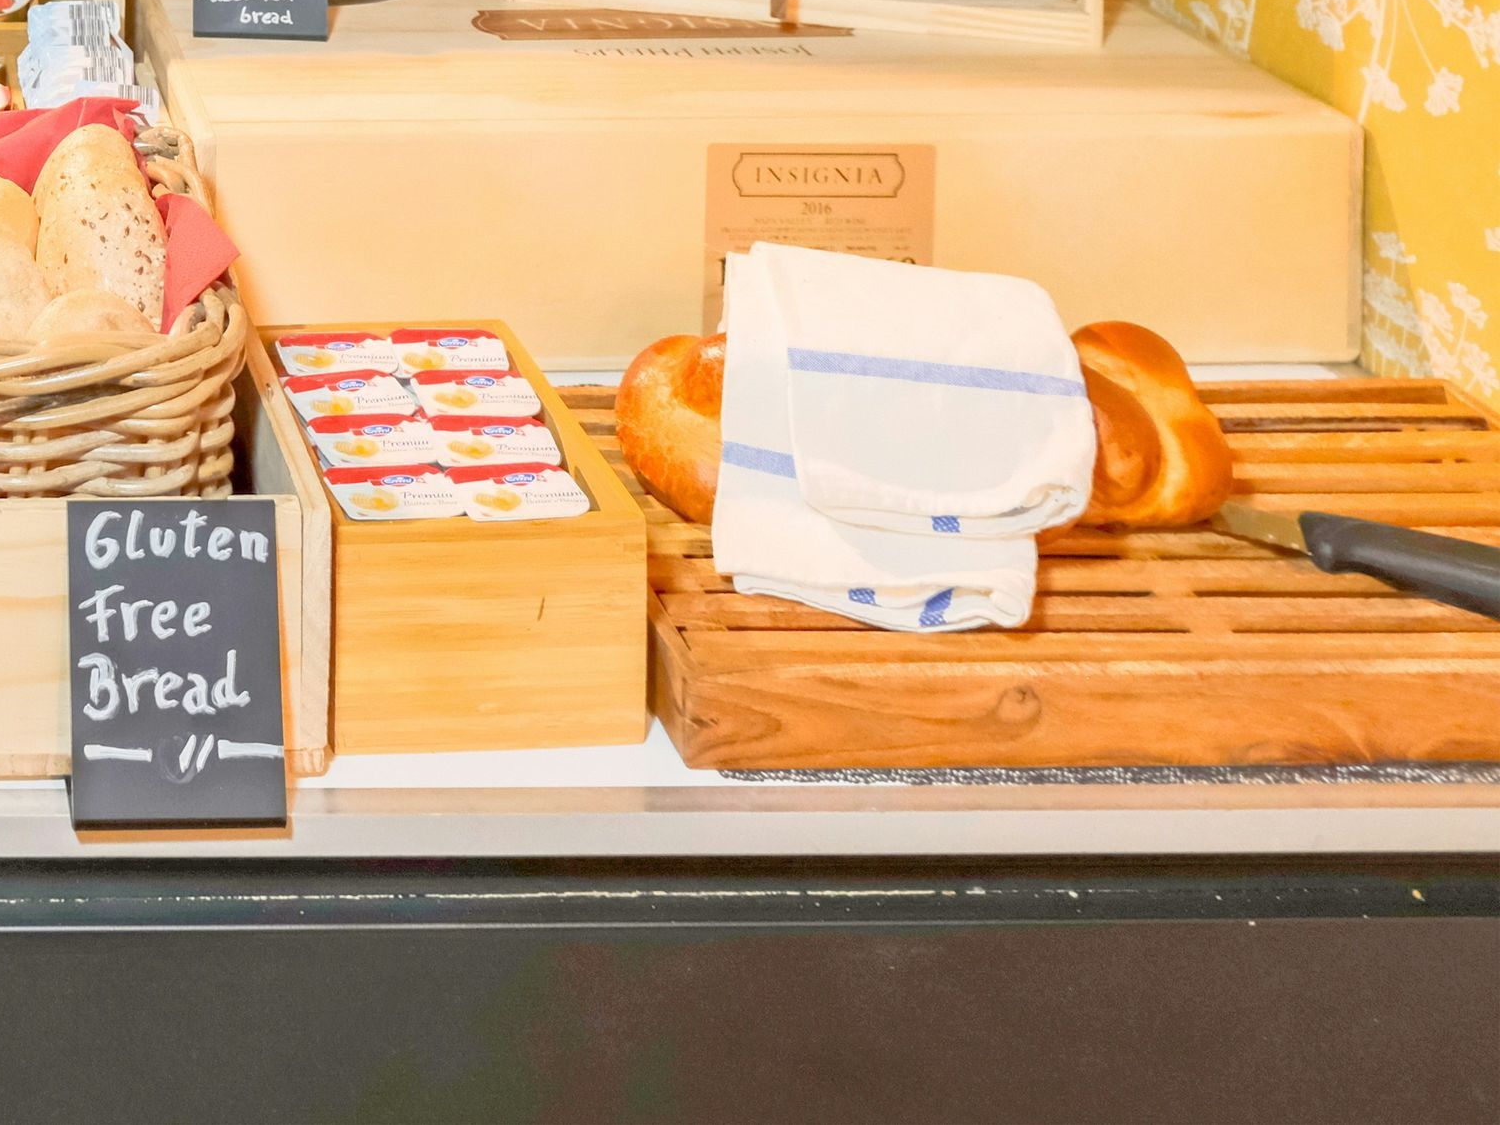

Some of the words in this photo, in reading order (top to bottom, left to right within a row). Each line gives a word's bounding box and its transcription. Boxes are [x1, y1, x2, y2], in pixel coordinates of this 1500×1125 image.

[239, 6, 294, 25] bread
[515, 16, 784, 32] SIGNIA
[754, 167, 884, 185] INSIGNIA
[801, 202, 833, 216] 2016
[85, 509, 269, 570] Gluten
[78, 584, 212, 643] Free
[78, 649, 251, 721] Bread
